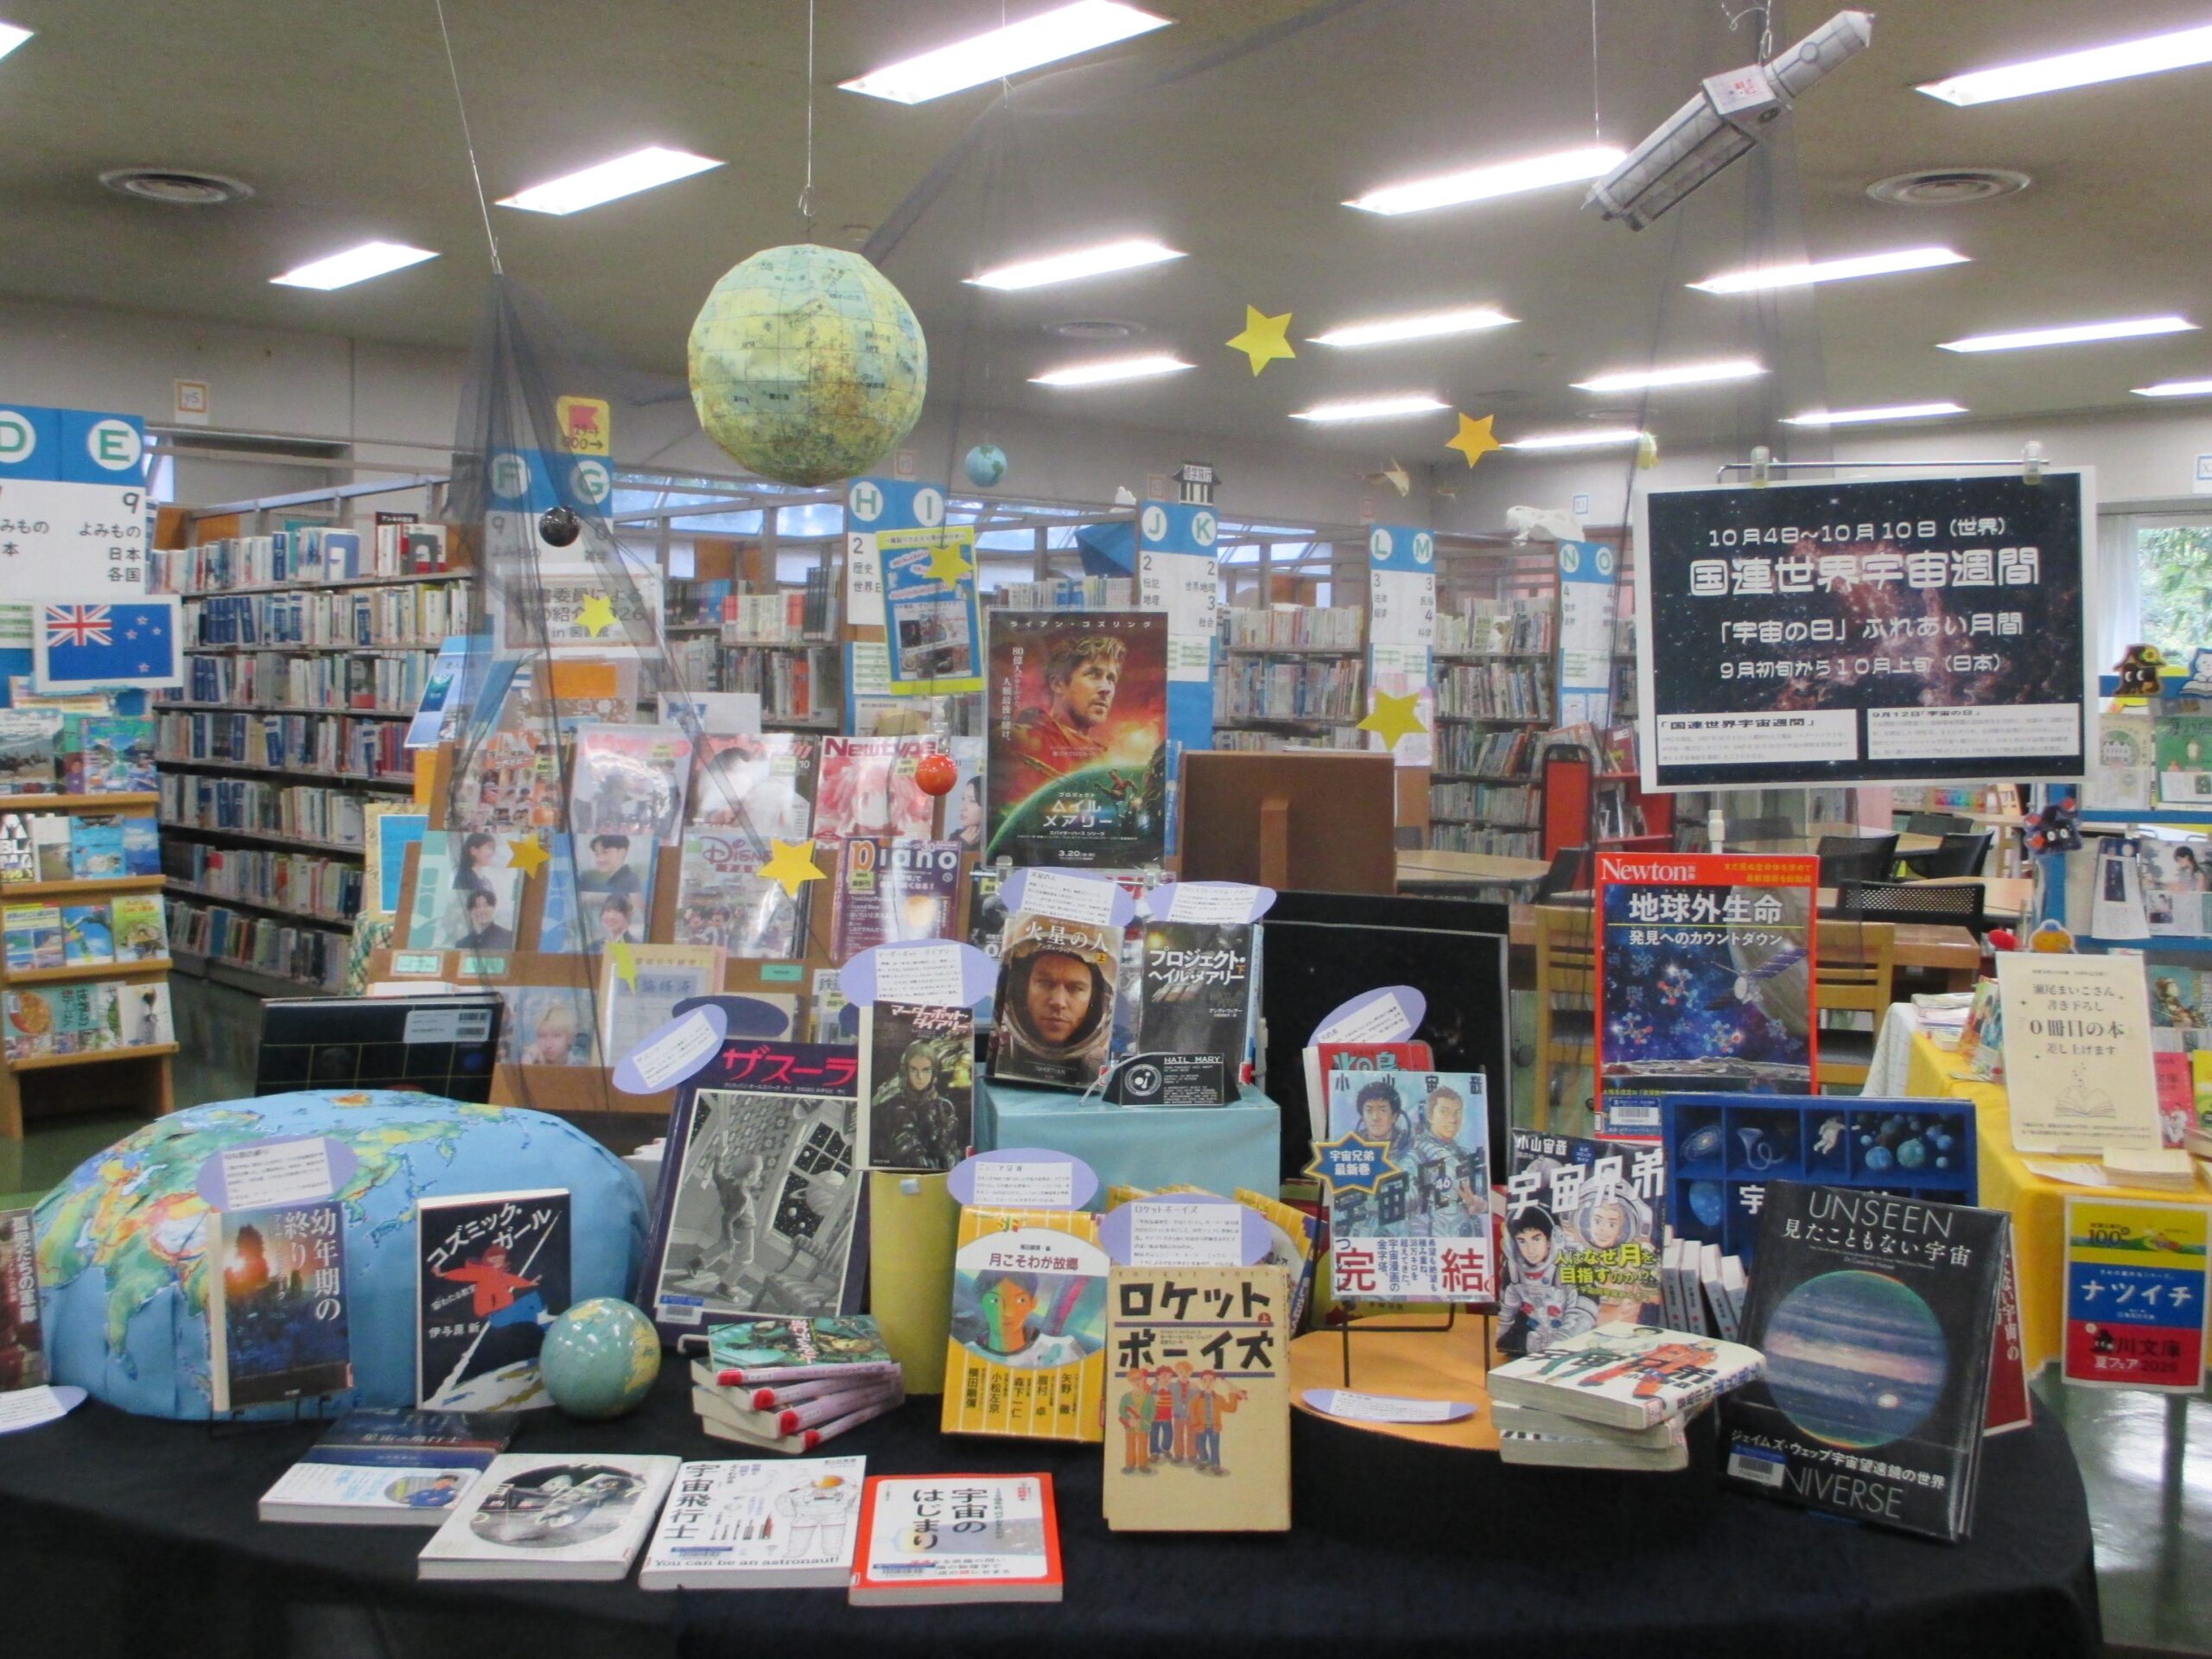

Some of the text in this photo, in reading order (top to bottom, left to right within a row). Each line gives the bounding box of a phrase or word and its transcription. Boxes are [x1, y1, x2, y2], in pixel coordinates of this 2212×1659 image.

[99, 429, 130, 461] E
[577, 469, 603, 495] G
[123, 493, 140, 514] 9
[855, 489, 878, 515] H
[926, 496, 932, 520] I
[79, 525, 142, 539] よみもの
[1147, 513, 1160, 536] J
[1196, 518, 1211, 540] K
[109, 547, 141, 562] 日本
[853, 537, 863, 554] 2
[1374, 535, 1387, 555] L
[1415, 539, 1430, 558] M
[1143, 556, 1153, 570] 2
[1207, 561, 1216, 576] 2
[1563, 550, 1576, 568] N
[1599, 551, 1611, 570] O
[107, 568, 141, 582] 各国
[1373, 574, 1381, 588] 3
[1689, 547, 2040, 596] 国連世界宇宙週間
[1426, 576, 1433, 591] 3
[1562, 585, 1571, 598] 4
[1143, 594, 1160, 606] 地理
[1207, 595, 1216, 611] 3
[1009, 619, 1153, 629] ライアン・ゴズリング
[1424, 607, 1433, 621] 4
[1720, 612, 2024, 645] 「宇宙の日」 ふれあい月間
[1661, 718, 1816, 730] 「国連世界宇宙週間」
[824, 737, 937, 758] Newtype
[1043, 815, 1113, 828] メアリー
[849, 840, 957, 872] piano
[1601, 858, 1688, 881] Newton
[1629, 892, 1783, 925] 地球外生命
[1025, 919, 1109, 952] 火星の人
[1629, 928, 1783, 946] 発見へのカウントダウン
[1148, 946, 1247, 971] プロジェクト・
[1147, 968, 1246, 987] ヘイル・メアリー
[1236, 963, 1246, 976] 下
[2047, 999, 2105, 1012] 書き下ろし
[2047, 1043, 2117, 1056] 差し上げます
[722, 1043, 858, 1086] ザスーラ
[1330, 1150, 1375, 1163] 宇宙兄弟
[1516, 1136, 1568, 1156] 小山宙哉
[1334, 1162, 1372, 1176] 最新巻
[1435, 1179, 1452, 1191] 46
[1506, 1147, 1665, 1220] 宇宙兄弟
[1808, 1191, 1955, 1239] UNSEEN
[426, 1202, 523, 1268] コズミック・
[492, 1209, 551, 1249] ガール
[284, 1211, 309, 1270] 終り
[1782, 1217, 1974, 1268] 見たこともない宇宙
[310, 1208, 341, 1322] 幼年期の
[988, 1253, 1079, 1271] 月こそわが故郷
[1335, 1247, 1377, 1292] 完
[1388, 1238, 1401, 1293] 宇宙漫画の
[1427, 1238, 1438, 1293] 希望も絶望も
[1120, 1281, 1271, 1320] ロケット
[2081, 1279, 2192, 1307] ナツイチ
[1118, 1328, 1274, 1370] ボーイズ
[2094, 1355, 2139, 1370] 夏フェア
[988, 1371, 1002, 1414] 小松左京
[664, 1465, 720, 1539] 宇宙飛行士
[1784, 1466, 1904, 1519] NIVERSE
[912, 1489, 944, 1549] はじまり
[951, 1488, 988, 1533] 宇宙の
[655, 1558, 681, 1567] You
[717, 1557, 735, 1566] be
[761, 1555, 840, 1565] astronaut!
